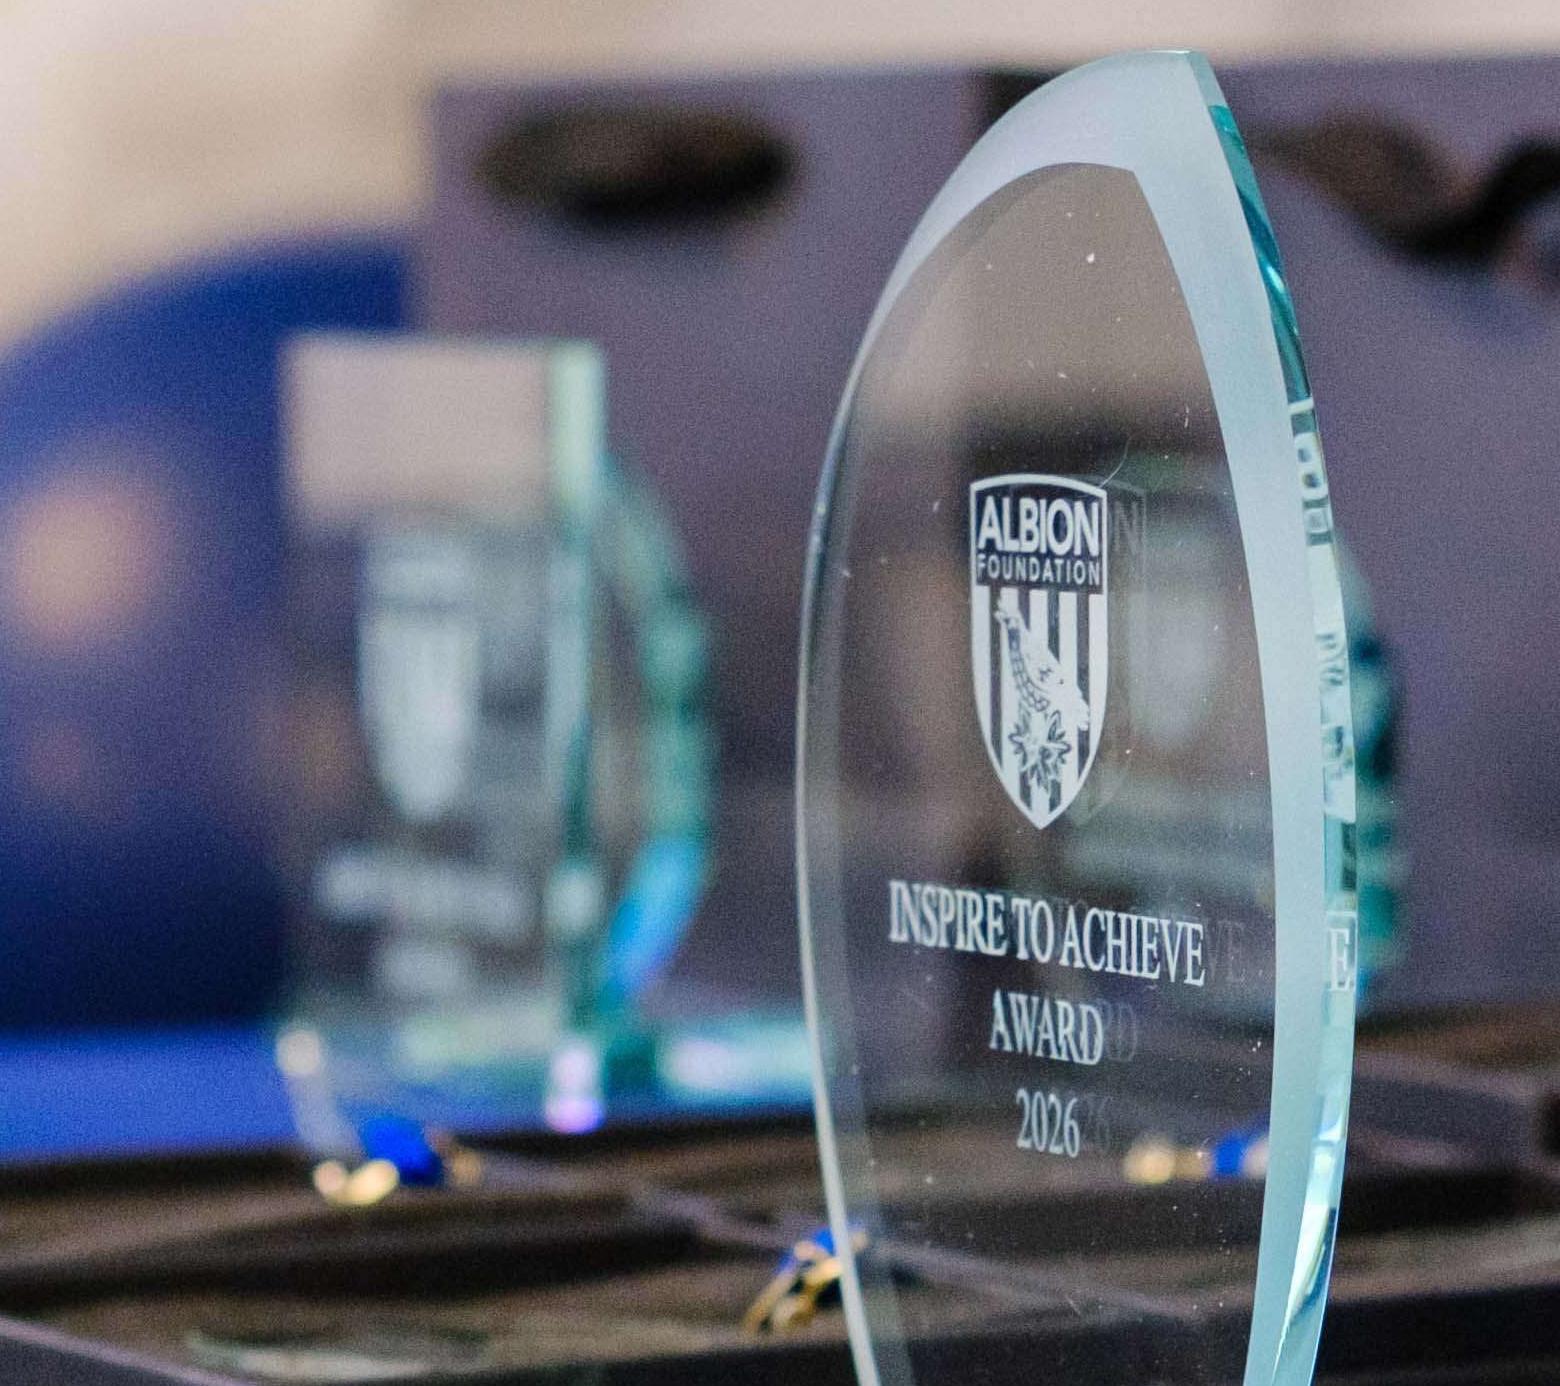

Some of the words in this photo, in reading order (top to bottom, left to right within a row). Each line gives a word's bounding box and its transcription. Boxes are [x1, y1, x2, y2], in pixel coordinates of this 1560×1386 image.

[978, 494, 1101, 557] ALBION
[977, 553, 1101, 586] FOUNDATION
[889, 879, 1008, 957] INSPIRE
[1011, 897, 1056, 964] TO
[1058, 904, 1206, 988] ACHIEVE
[989, 988, 1104, 1066] AWARD
[1015, 1087, 1081, 1158] 2026
